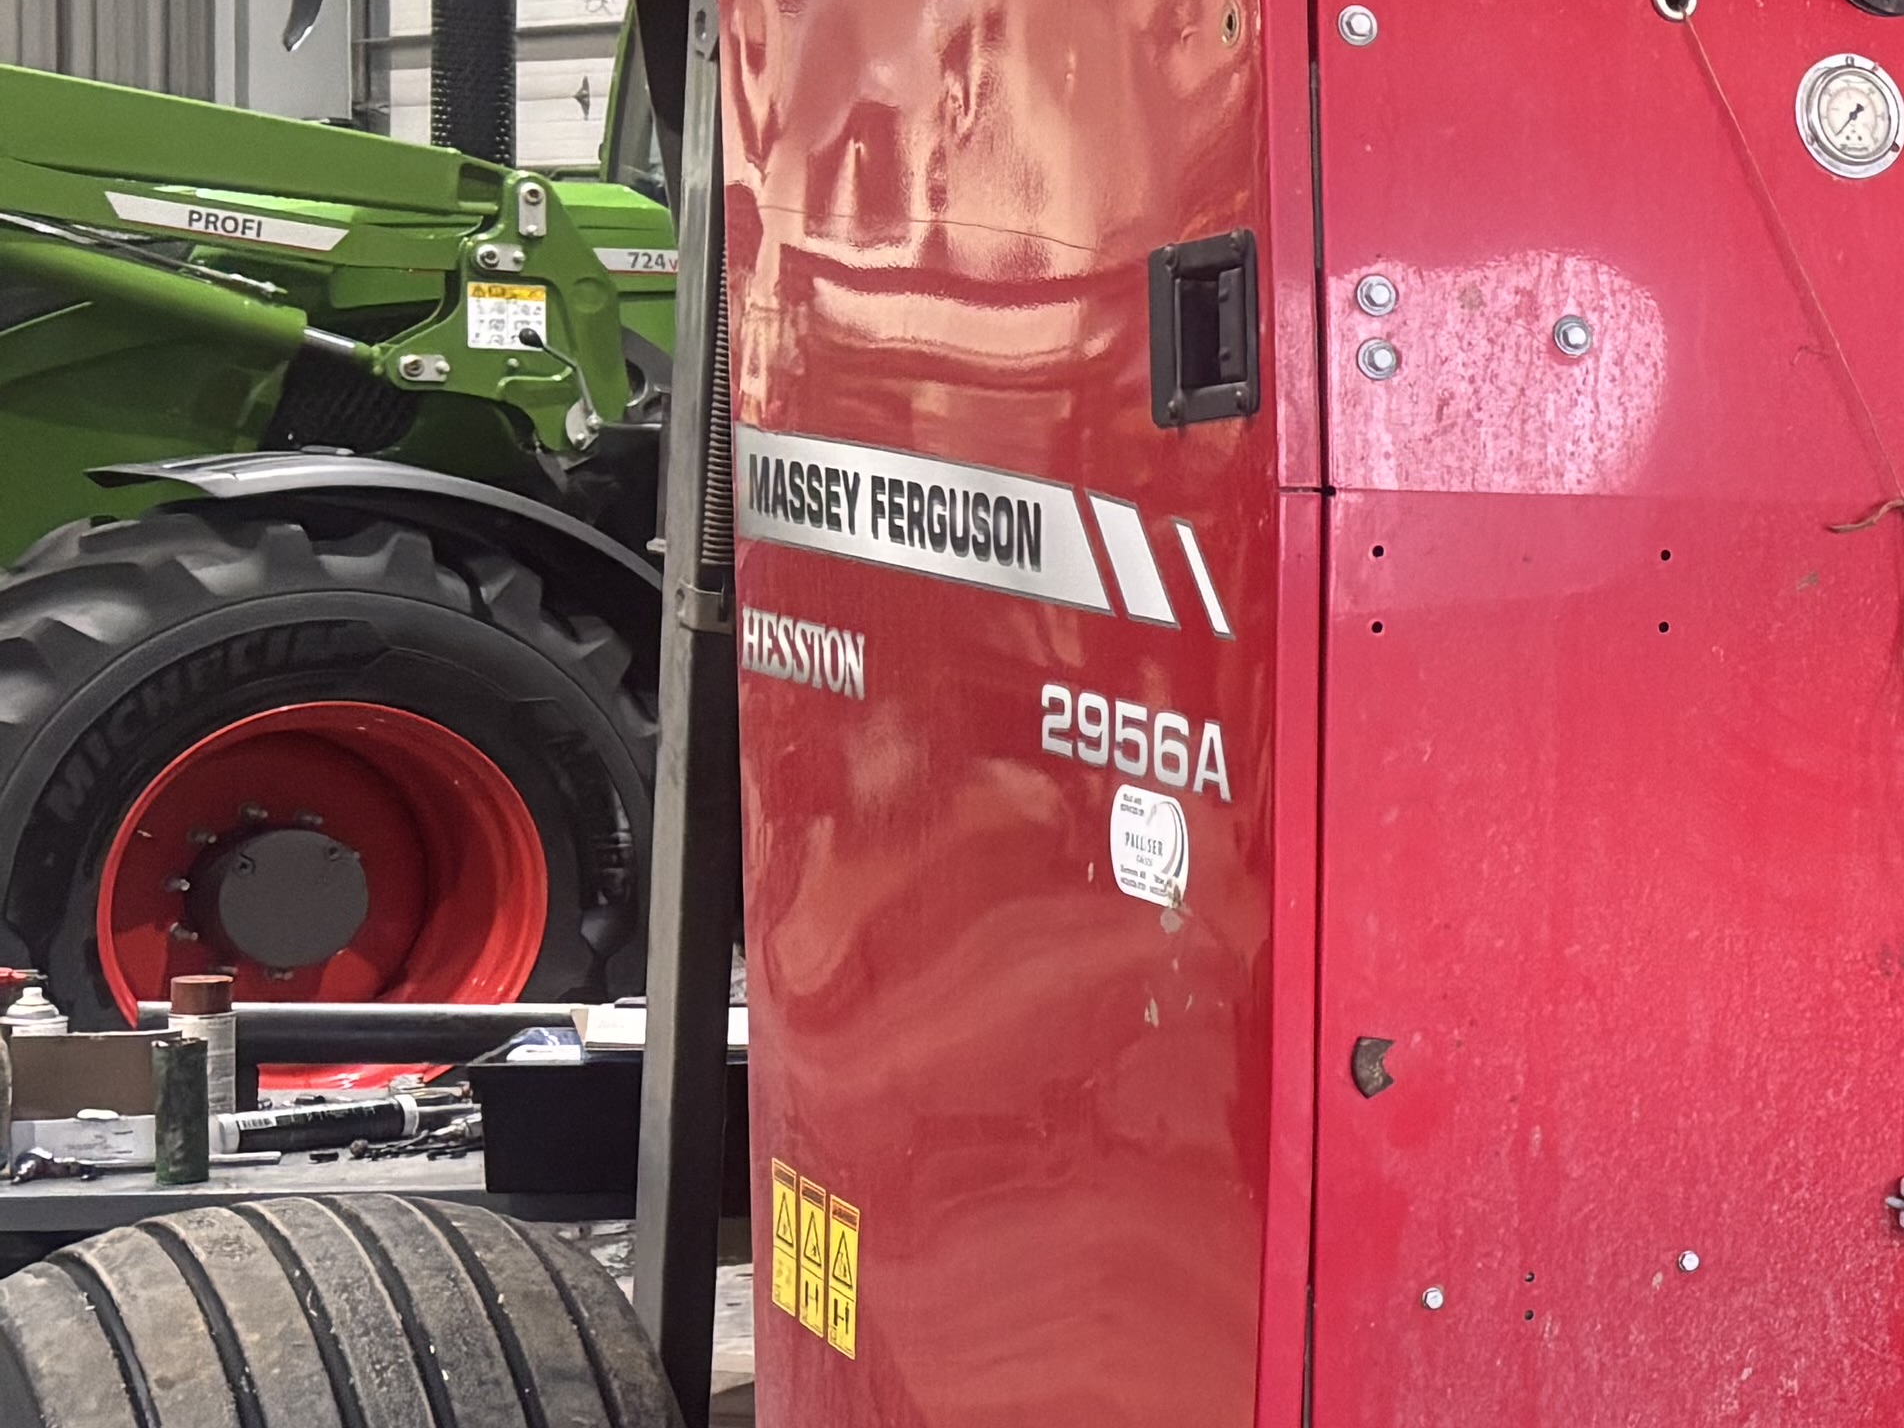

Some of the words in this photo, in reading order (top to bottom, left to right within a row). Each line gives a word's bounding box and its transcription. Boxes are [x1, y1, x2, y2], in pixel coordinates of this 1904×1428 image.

[188, 209, 262, 238] PROFI
[627, 252, 666, 269] 724
[750, 453, 860, 535] MASSEY
[871, 475, 1042, 572] FERGUSON
[742, 606, 865, 700] HESSTON
[1041, 683, 1232, 803] 2956A
[1125, 831, 1163, 856] PALLSER
